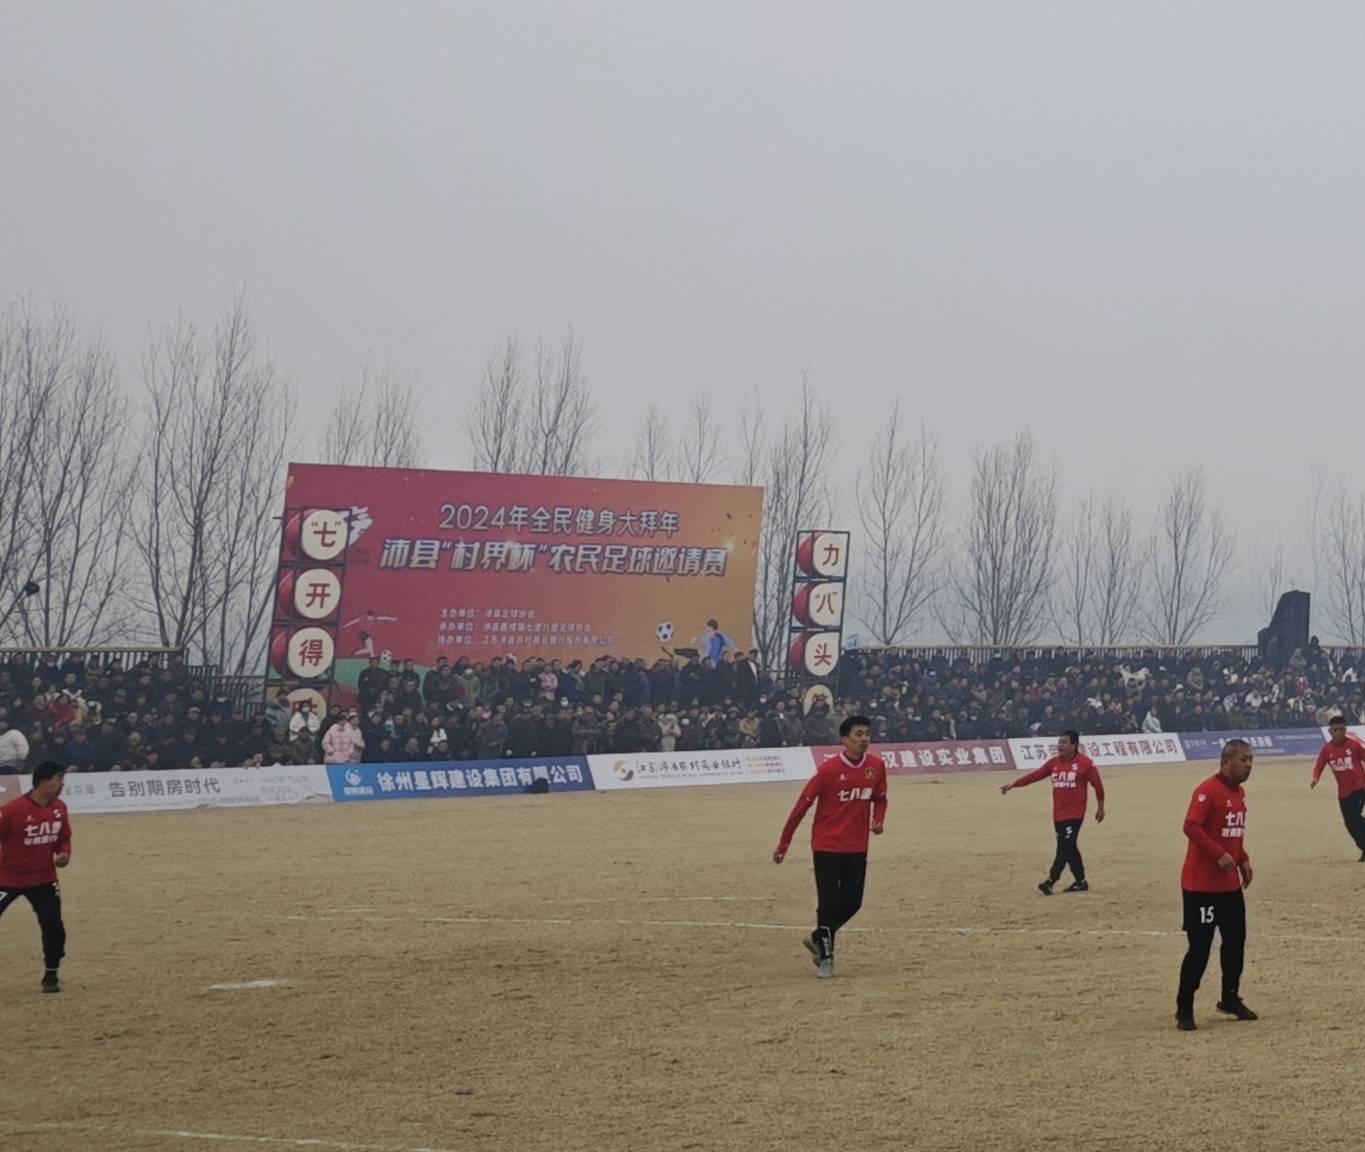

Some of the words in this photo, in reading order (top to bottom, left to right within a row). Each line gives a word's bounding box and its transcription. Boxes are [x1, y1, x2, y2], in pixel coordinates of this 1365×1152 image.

[438, 504, 679, 536] 2024年全民健身大拜年
[108, 777, 221, 798] 告别期房时代
[1200, 906, 1215, 924] 15
